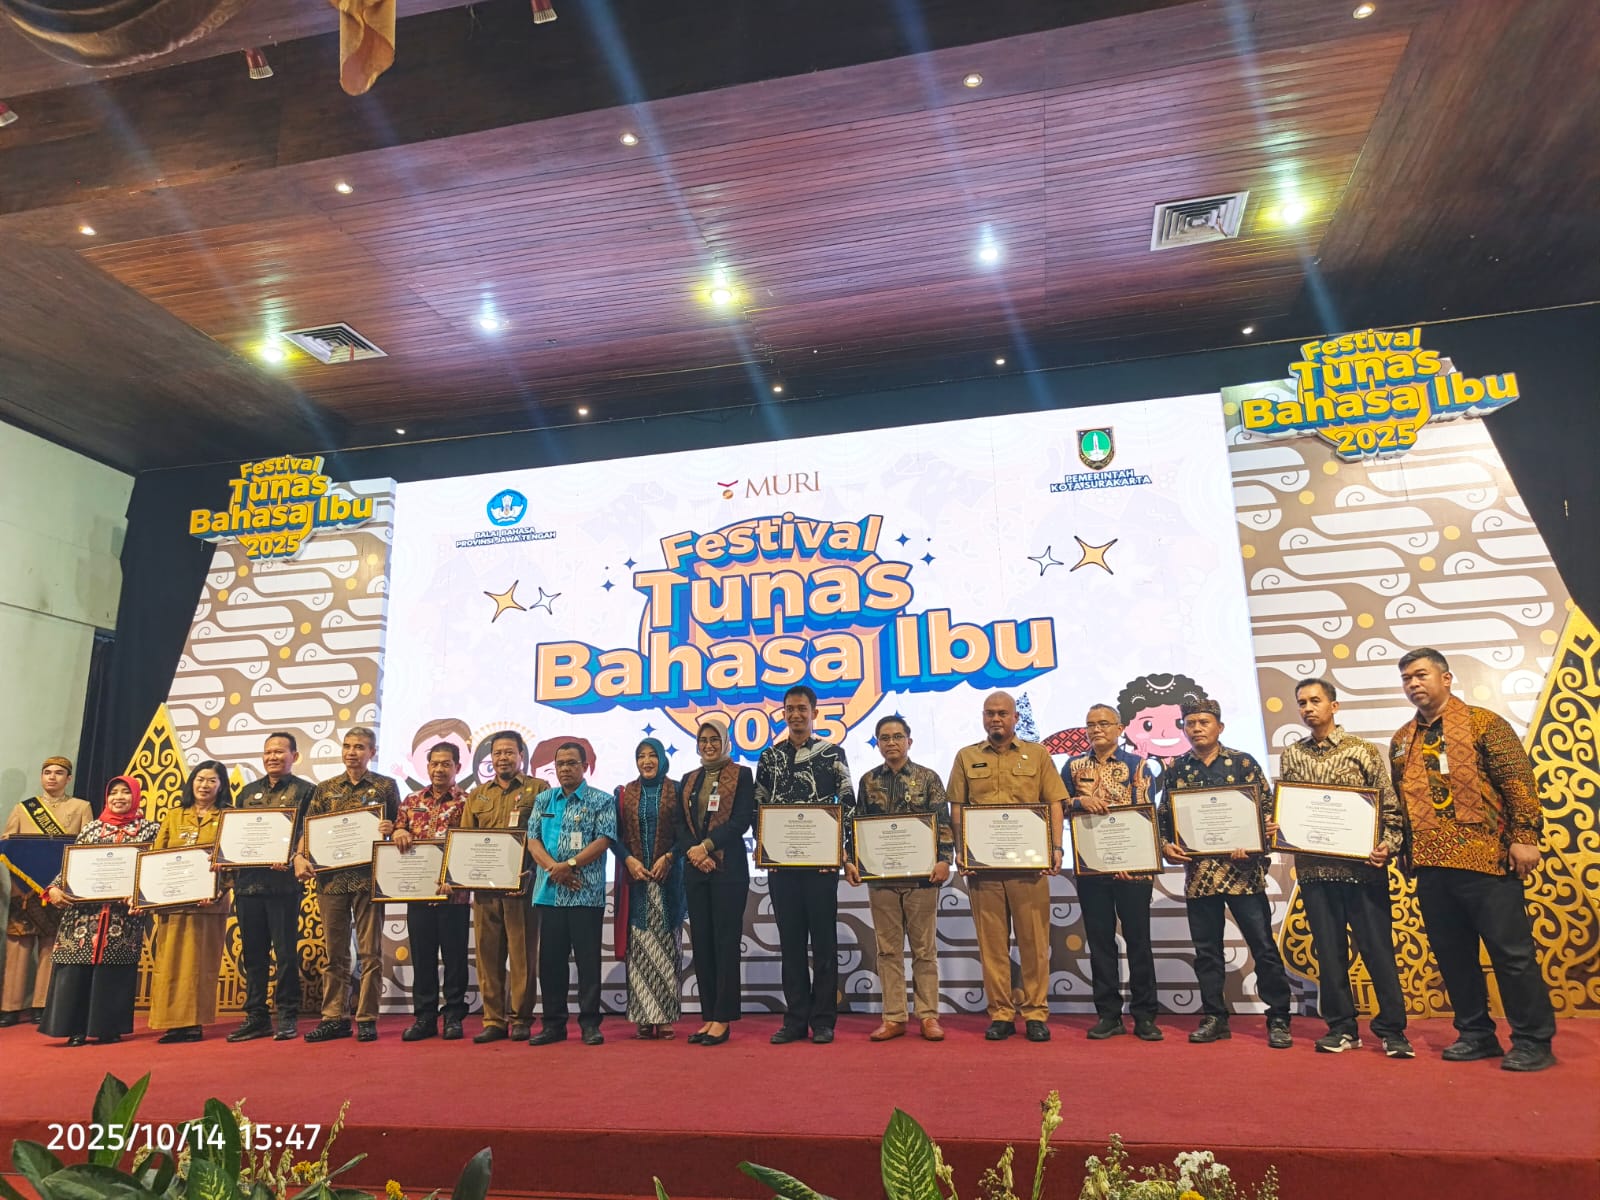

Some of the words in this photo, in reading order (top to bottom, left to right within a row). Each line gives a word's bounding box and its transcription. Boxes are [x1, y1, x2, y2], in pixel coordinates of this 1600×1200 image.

[1302, 328, 1422, 360] Festival
[1290, 350, 1442, 389] Tunas
[1242, 386, 1420, 429] Bahasa
[1434, 371, 1519, 406] Ibu
[1336, 424, 1418, 452] 2025
[240, 454, 321, 478] Festival
[1065, 469, 1134, 483] PEMERINTAH
[229, 475, 329, 503] Tunas
[745, 471, 821, 498] MURI
[1050, 482, 1082, 493] KOTA
[1084, 475, 1152, 489] SURAKARTA
[189, 503, 308, 535] Bahasa
[319, 495, 373, 521] Ibu
[246, 534, 301, 557] 2025
[456, 538, 495, 548] PROVINSI
[495, 535, 521, 544] JAWA
[521, 531, 556, 541] TENGAH
[474, 530, 500, 539] BALAI
[501, 527, 535, 536] BAHASA
[661, 512, 883, 570] Festival
[635, 562, 913, 627] Tunas
[536, 631, 863, 701] Bahasa
[896, 610, 1057, 677] Ibu
